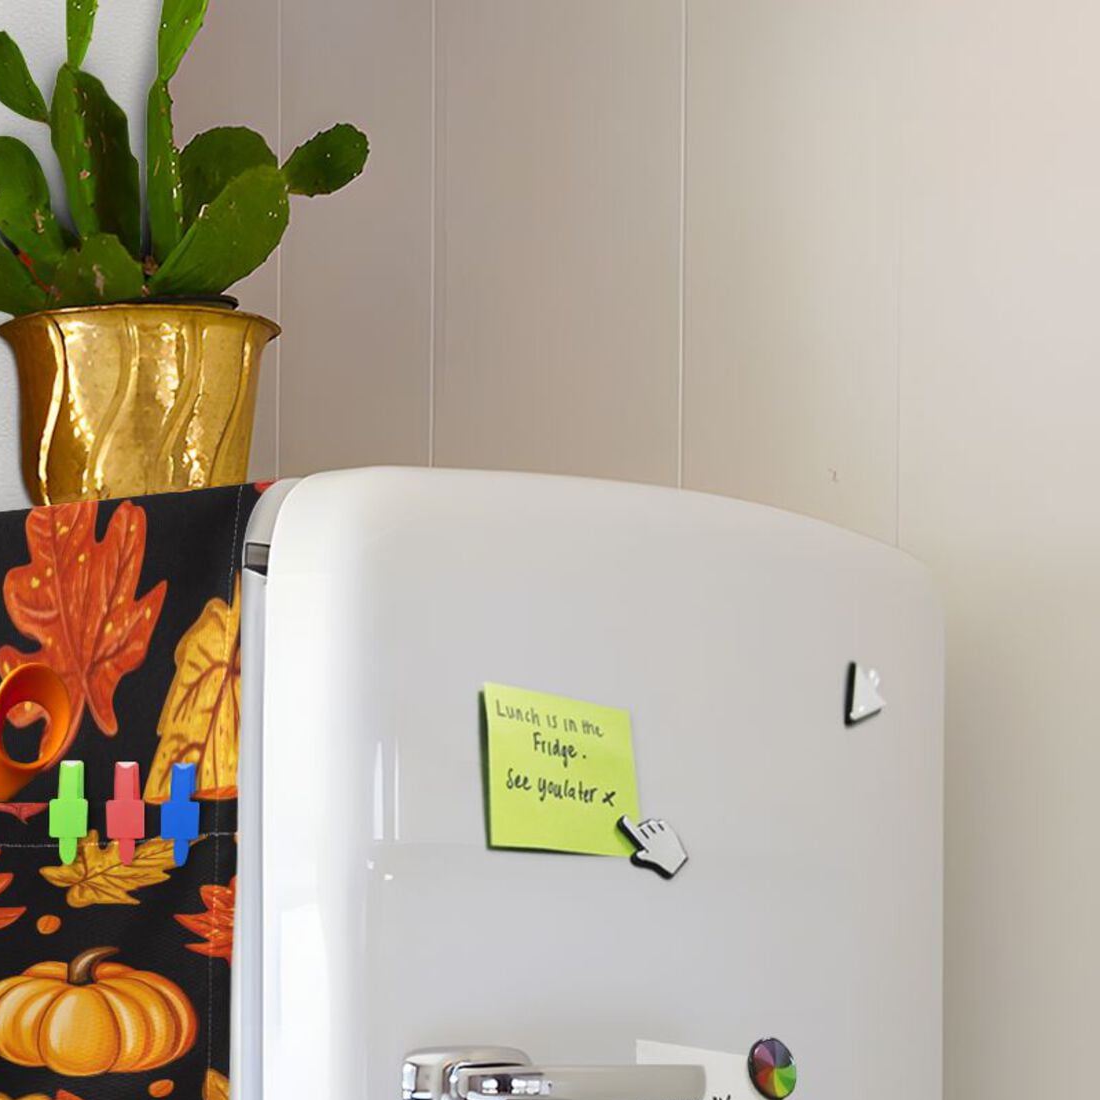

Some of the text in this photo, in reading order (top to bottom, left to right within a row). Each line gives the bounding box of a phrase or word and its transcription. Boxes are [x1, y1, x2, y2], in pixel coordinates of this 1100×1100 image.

[496, 699, 604, 737] Lunch is in the
[533, 732, 586, 768] Fridge.
[506, 768, 532, 790] See
